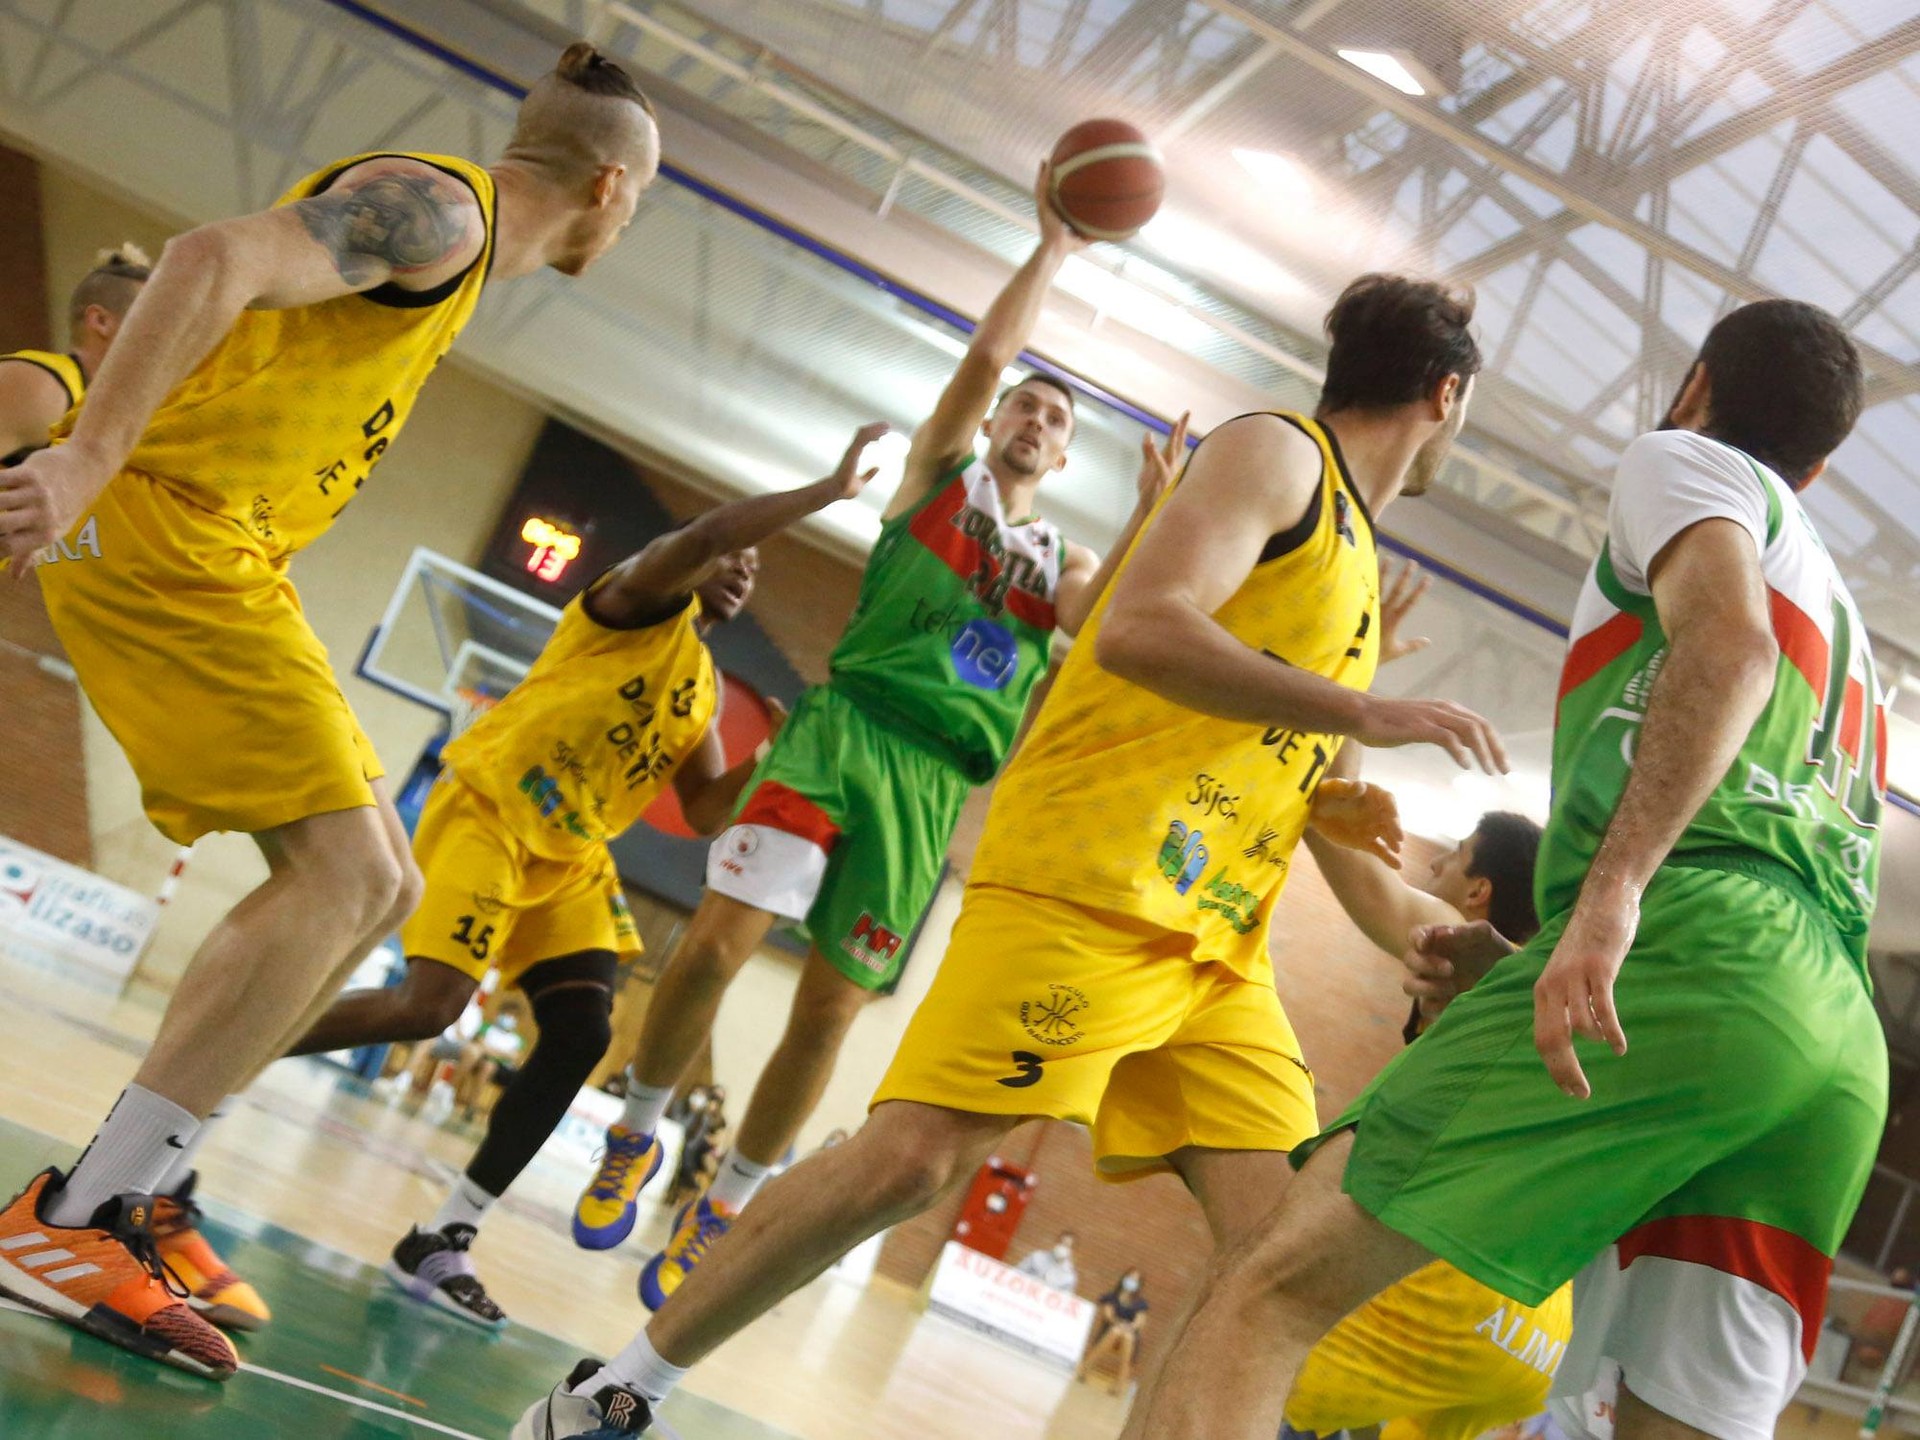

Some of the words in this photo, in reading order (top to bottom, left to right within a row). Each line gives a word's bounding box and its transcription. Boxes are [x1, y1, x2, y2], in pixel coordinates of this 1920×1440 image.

[450, 914, 495, 960] 15
[995, 1050, 1045, 1088] 3
[1474, 1304, 1569, 1378] ALIM
